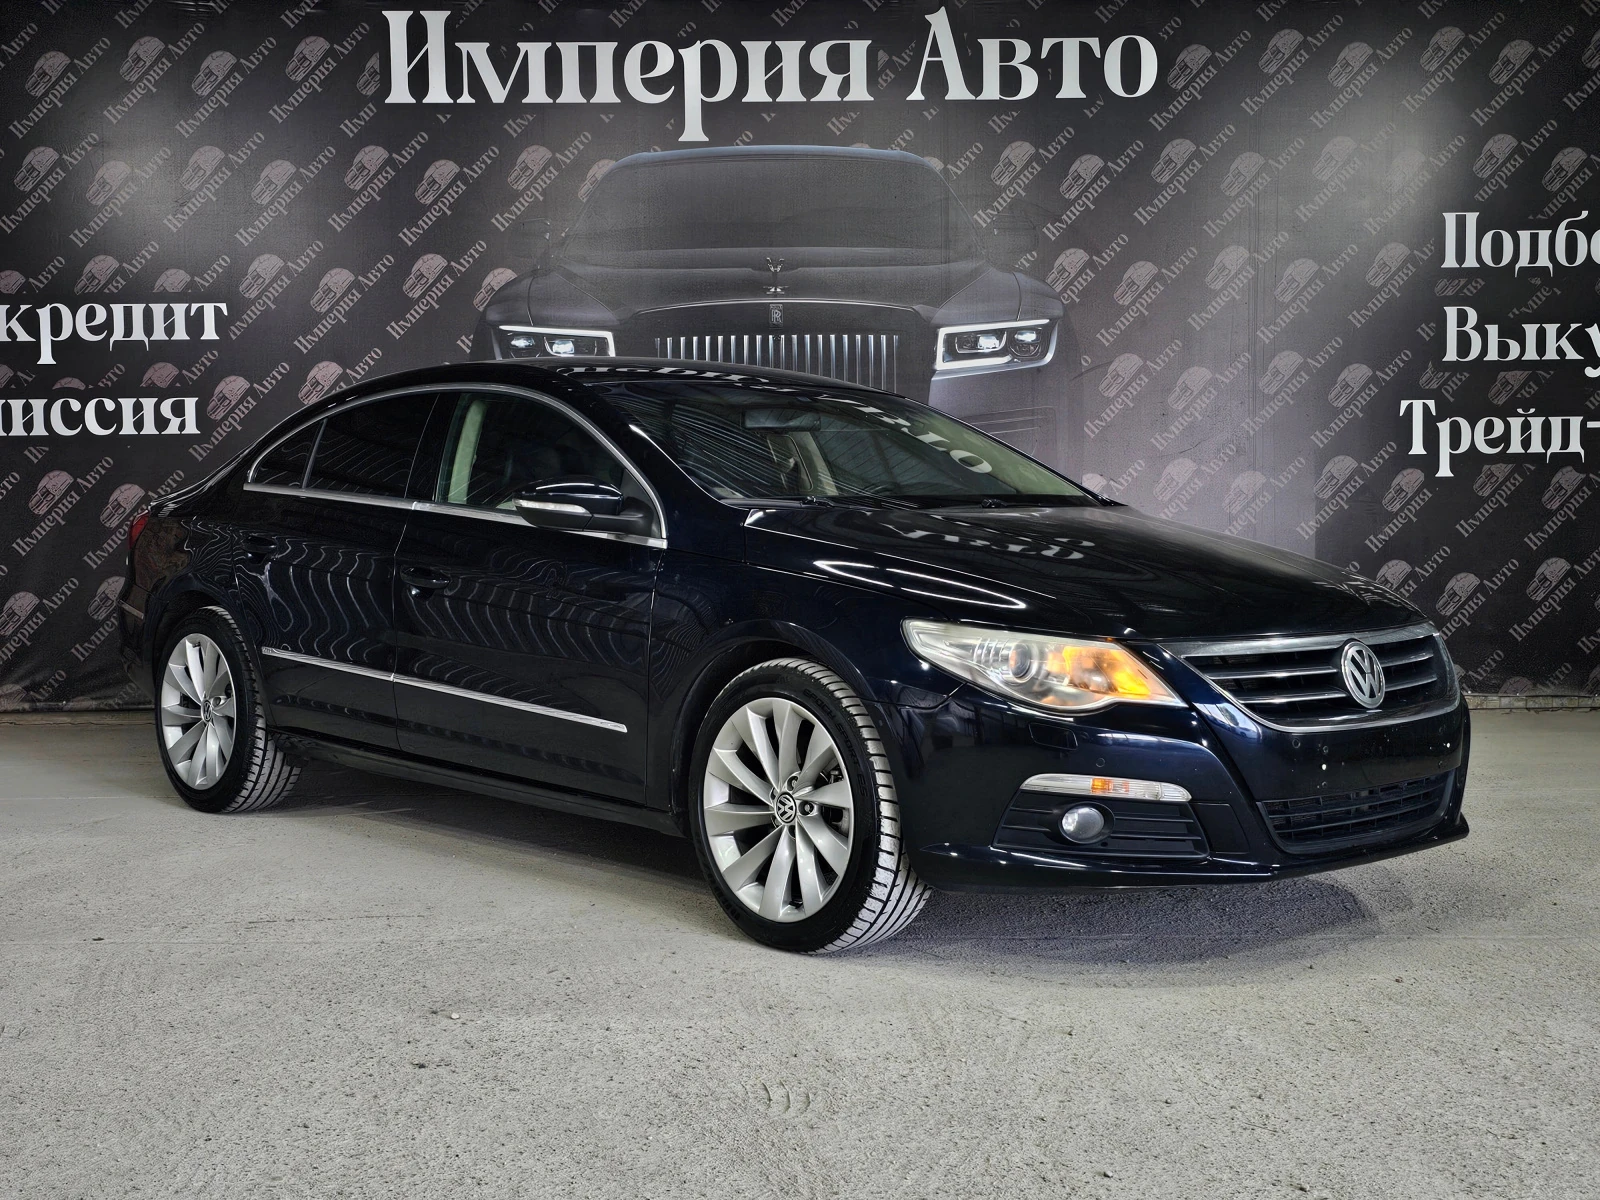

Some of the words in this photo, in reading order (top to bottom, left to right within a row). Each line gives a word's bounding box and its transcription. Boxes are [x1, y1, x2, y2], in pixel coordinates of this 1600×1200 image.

[8, 72, 77, 139] Империя
[74, 37, 111, 75] Авто
[102, 57, 171, 124] Империя
[168, 22, 205, 60] Авто
[174, 71, 243, 138] Империя
[240, 36, 277, 74] Авто
[267, 57, 336, 124] Империя
[333, 22, 370, 60] Авто
[382, 10, 874, 142] Империя
[905, 5, 1158, 101] Авто
[1149, 64, 1218, 131] Империя
[1215, 29, 1252, 67] Авто
[1241, 49, 1310, 116] Империя
[1307, 14, 1344, 52] Авто
[1310, 62, 1379, 129] Империя
[1376, 27, 1413, 65] Авто
[1402, 47, 1471, 114] Империя
[1468, 12, 1505, 50] Авто
[1471, 60, 1540, 127] Империя
[1537, 25, 1574, 63] Авто
[0, 167, 66, 234] Империя
[63, 132, 100, 170] Авто
[162, 167, 231, 234] Империя
[228, 132, 265, 170] Авто
[325, 166, 394, 233] Империя
[391, 131, 428, 169] Авто
[489, 167, 558, 234] Империя
[555, 132, 592, 170] Авто
[972, 161, 1041, 228] Империя
[1038, 126, 1075, 164] Авто
[1133, 158, 1202, 225] Империя
[1199, 123, 1236, 161] Авто
[1521, 119, 1558, 157] Авто
[233, 181, 302, 248] Империя
[299, 146, 336, 184] Авто
[396, 181, 465, 248] Империя
[462, 146, 499, 184] Авто
[1041, 175, 1110, 242] Империя
[1107, 140, 1144, 178] Авто
[287, 240, 324, 278] Авто
[384, 275, 453, 342] Империя
[450, 240, 487, 278] Авто
[1091, 234, 1128, 272] Авто
[1094, 282, 1163, 349] Империя
[1160, 247, 1197, 285] Авто
[1186, 266, 1255, 333] Империя
[1252, 231, 1289, 269] Авто
[1255, 279, 1324, 346] Империя
[1321, 244, 1358, 282] Авто
[1347, 262, 1416, 330] Империя
[0, 303, 228, 365] кредит
[292, 289, 361, 356] Империя
[358, 254, 395, 292] Авто
[0, 397, 201, 436] иссия
[187, 397, 256, 464] Империя
[253, 362, 290, 400] Авто
[1080, 373, 1149, 440] Империя
[1146, 338, 1183, 376] Авто
[1149, 387, 1218, 454] Империя
[1215, 352, 1252, 390] Авто
[1240, 371, 1309, 438] Империя
[1306, 336, 1343, 374] Авто
[1309, 384, 1378, 451] Империя
[1375, 349, 1412, 387] Авто
[11, 491, 80, 558] Империя
[77, 456, 114, 494] Авто
[1294, 476, 1363, 543] Империя
[1360, 441, 1397, 479] Авто
[1364, 488, 1433, 552] Империя
[1455, 472, 1523, 537] Империя
[1523, 484, 1592, 551] Империя
[42, 577, 79, 615] Авто
[1482, 558, 1519, 596] Авто
[1509, 576, 1577, 642] Империя
